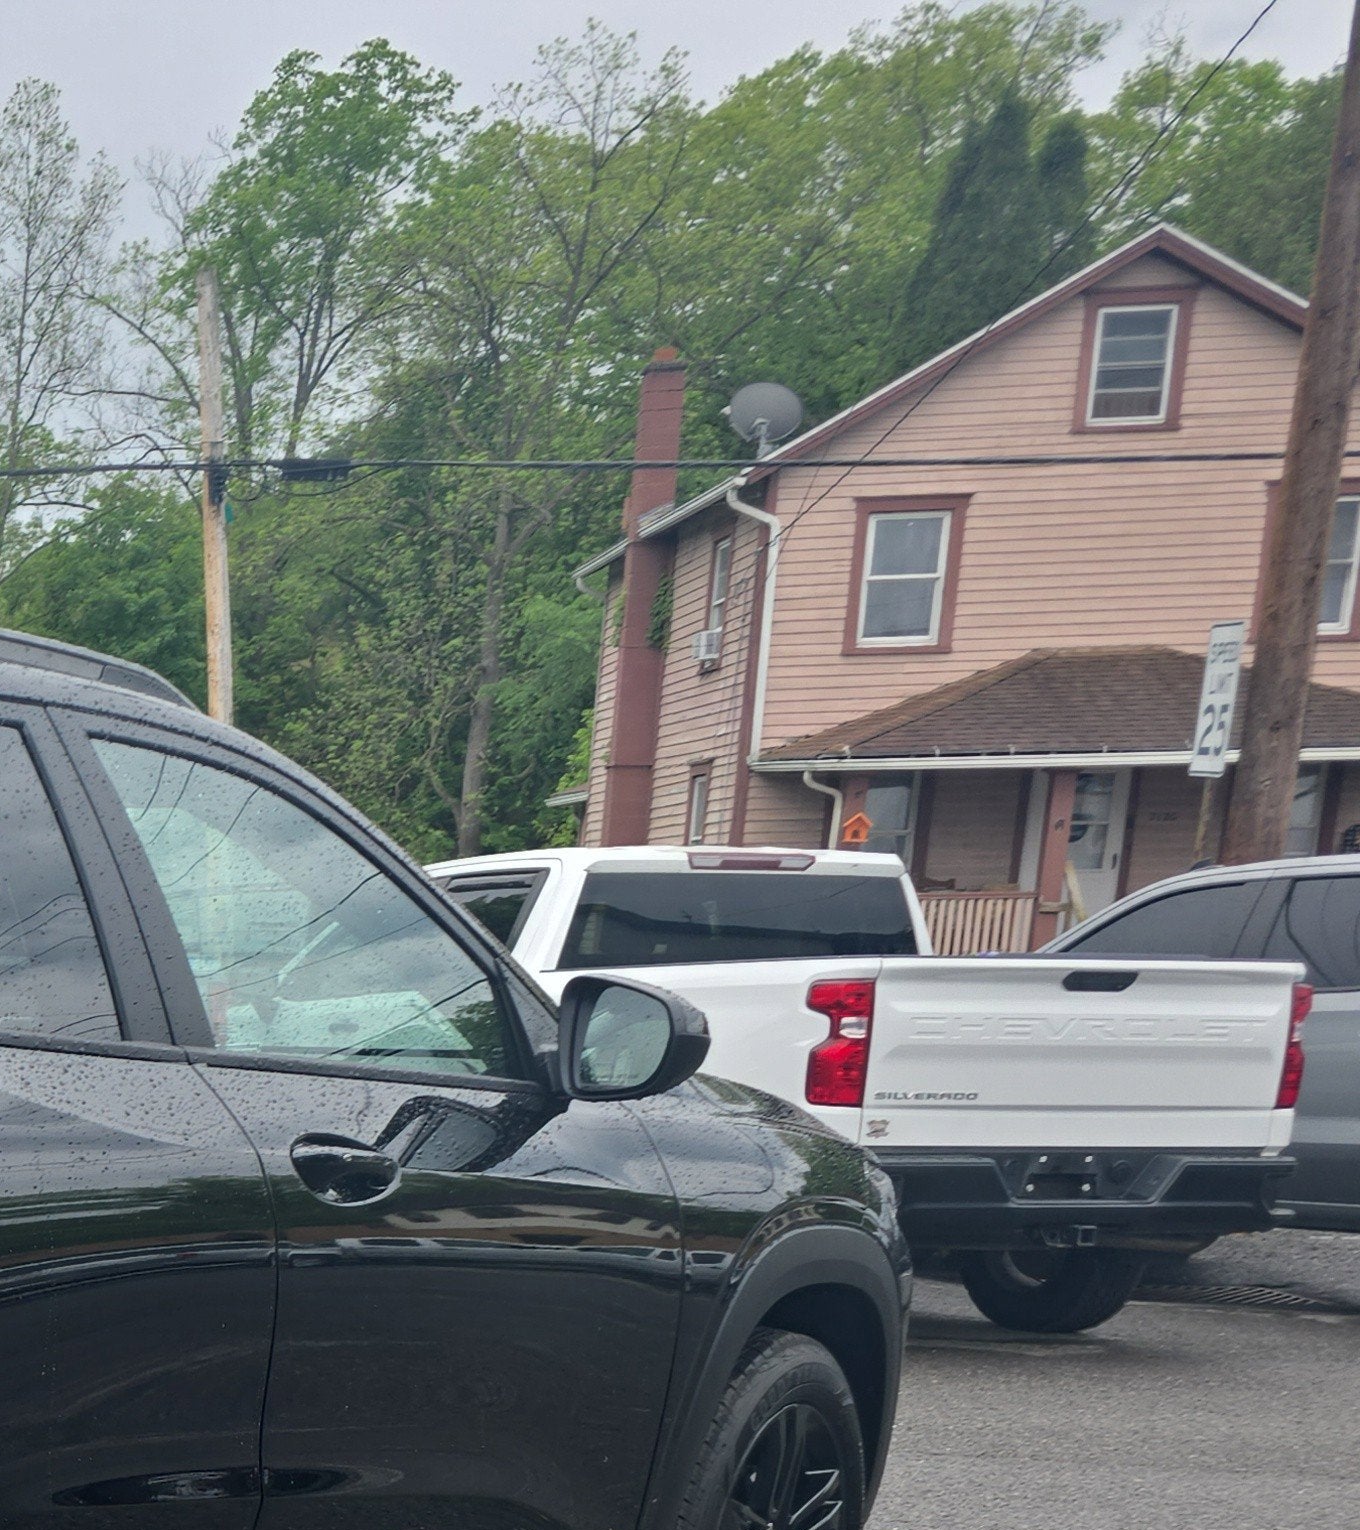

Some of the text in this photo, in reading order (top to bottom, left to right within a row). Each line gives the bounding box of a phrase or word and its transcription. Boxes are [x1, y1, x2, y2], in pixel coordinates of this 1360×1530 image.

[1197, 703, 1230, 757] 25
[908, 1016, 1268, 1043] CHEVROLET
[874, 1091, 979, 1101] SILVERADO
